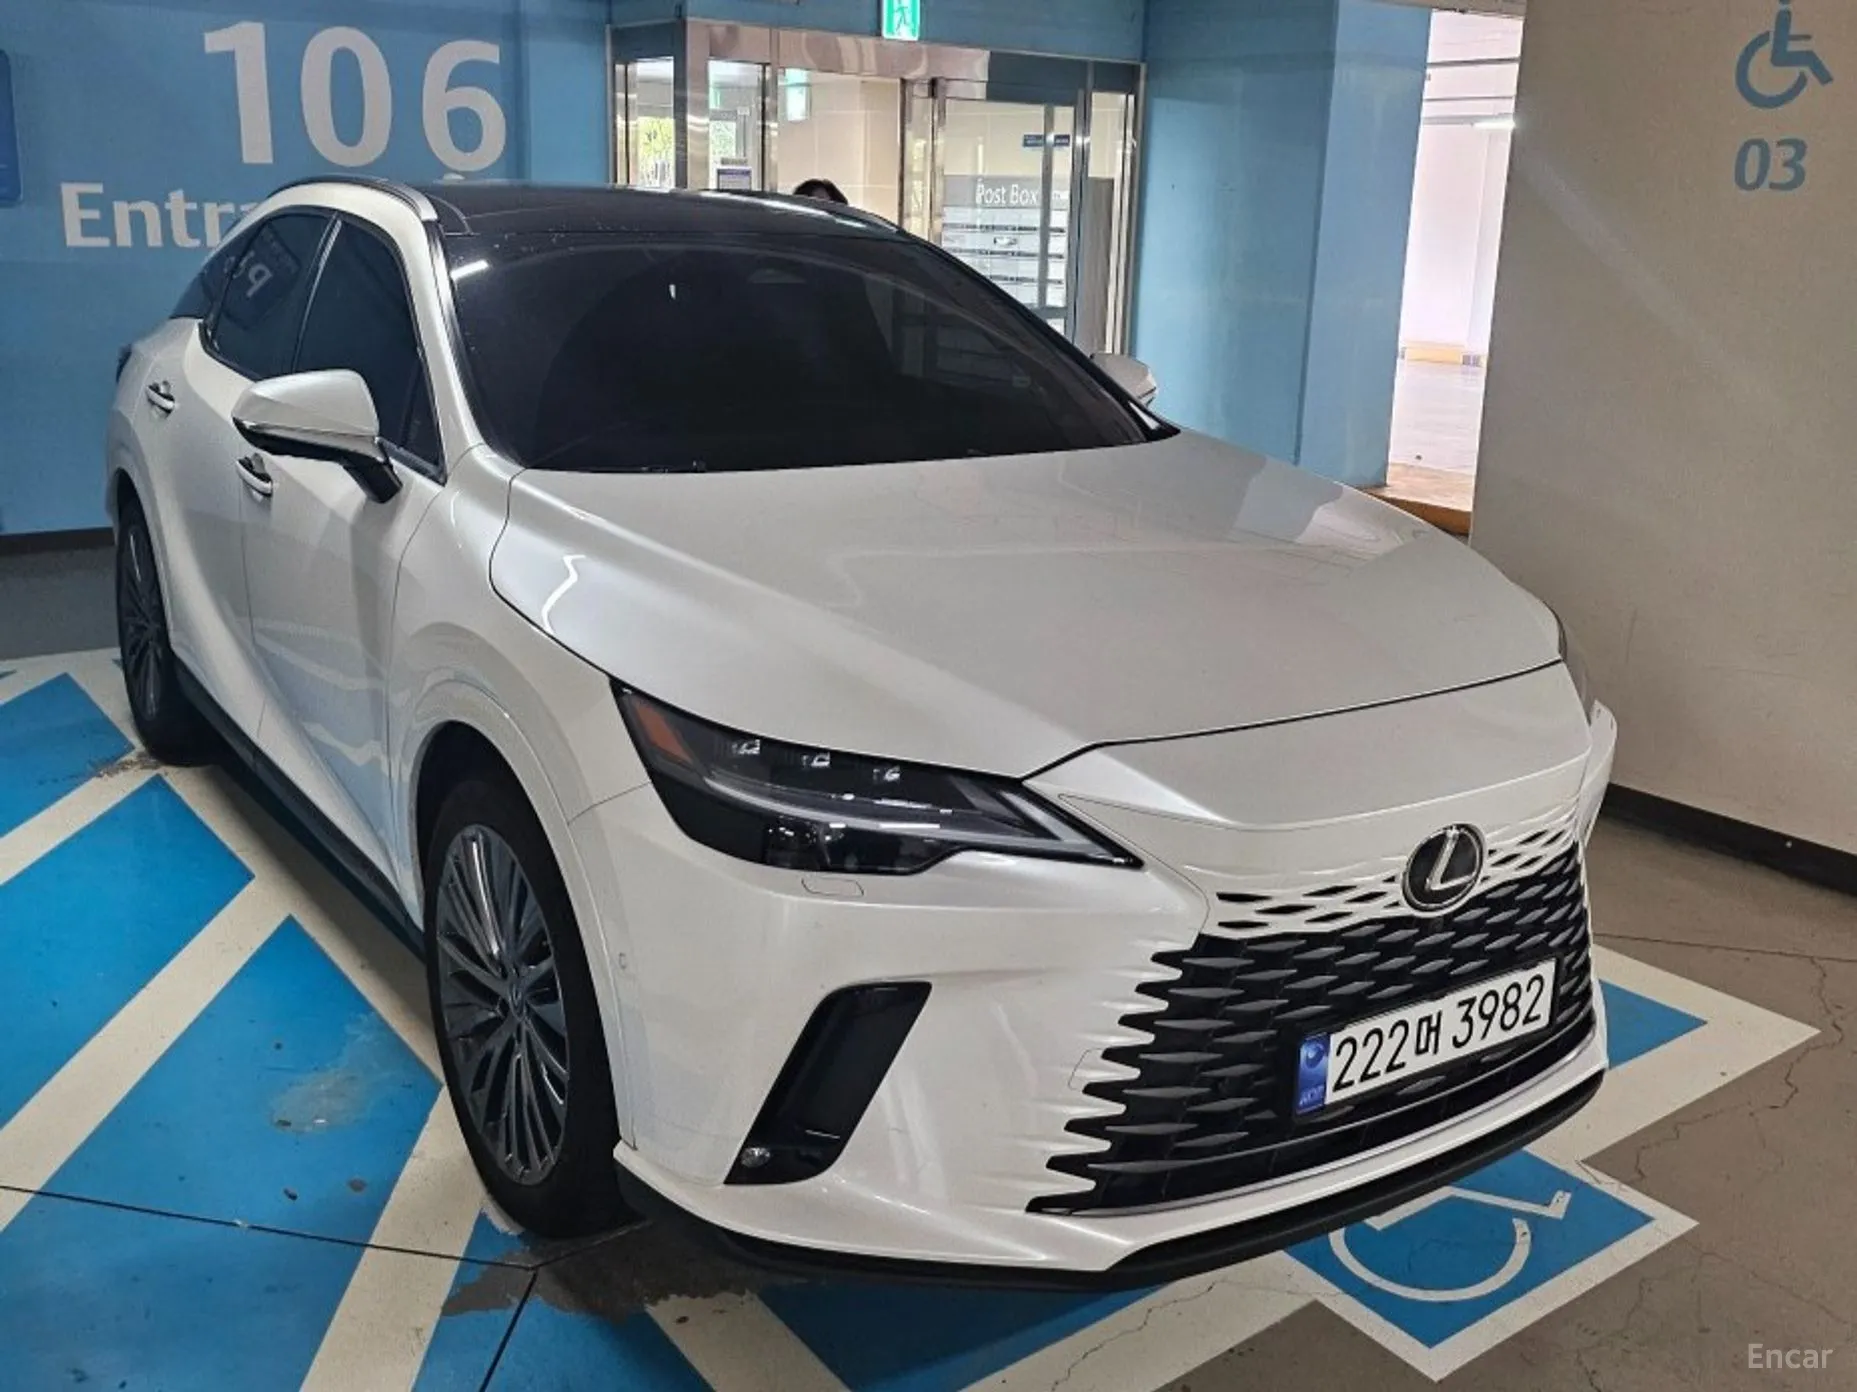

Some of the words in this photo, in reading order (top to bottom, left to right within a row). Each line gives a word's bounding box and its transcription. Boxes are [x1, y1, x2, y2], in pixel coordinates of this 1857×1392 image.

[204, 21, 507, 173] 106
[975, 183, 1006, 205] Post
[1010, 183, 1038, 206] Box
[1734, 138, 1808, 191] 03
[61, 182, 257, 248] Entr
[1332, 1010, 1443, 1093] 222머
[1452, 974, 1545, 1049] 3982
